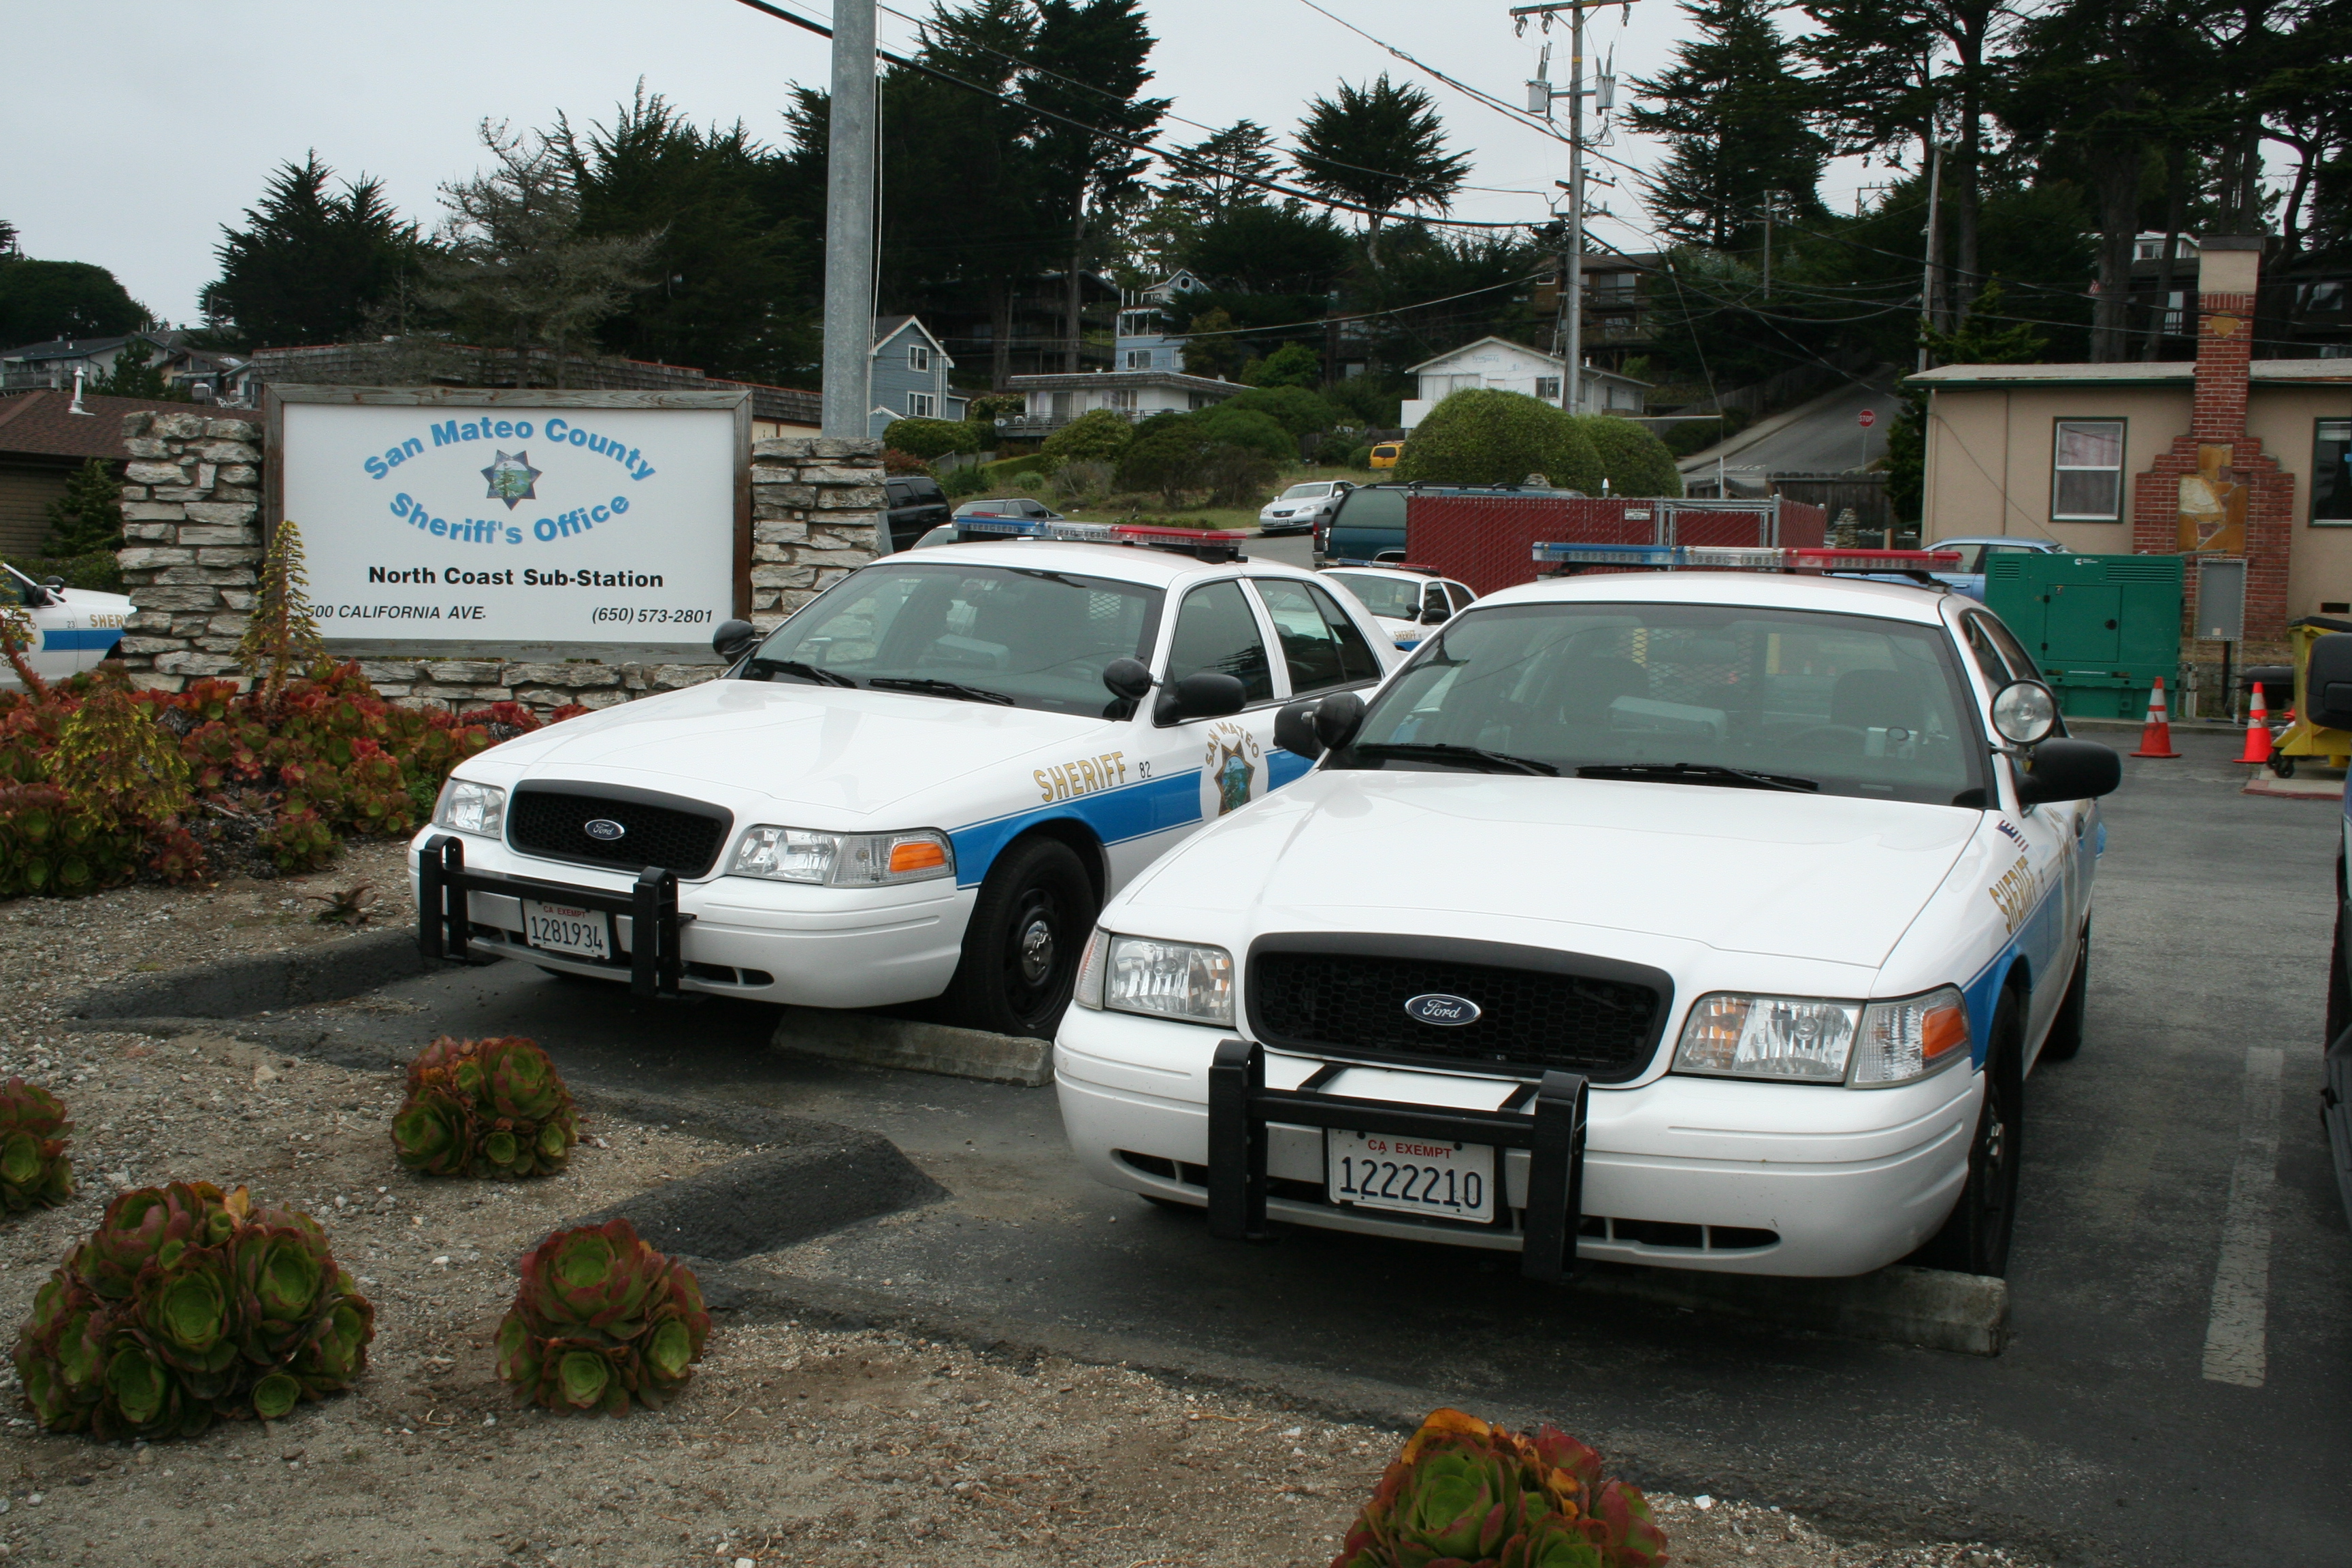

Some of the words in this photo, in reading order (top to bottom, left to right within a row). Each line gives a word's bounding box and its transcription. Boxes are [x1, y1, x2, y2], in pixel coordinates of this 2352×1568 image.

[363, 436, 425, 480] San
[430, 416, 534, 447] Mateo
[544, 418, 657, 482] County
[389, 492, 524, 544] Sheriff's
[534, 495, 630, 542] Office
[368, 566, 436, 585] North
[444, 567, 514, 586] Coast
[523, 568, 664, 588] Sub-Station
[90, 614, 127, 627] SHER
[338, 605, 441, 619] CALIFORNIA
[447, 606, 487, 619] AVE.
[592, 606, 634, 625] (650)
[637, 609, 713, 623] 573-2801
[1205, 728, 1221, 768] SAN
[1214, 721, 1260, 759] MATEO
[1032, 750, 1126, 802] SHERIFF
[1139, 761, 1152, 779] 82
[593, 822, 615, 836] Ford
[543, 905, 554, 913] CA
[557, 907, 586, 919] EXEMPT
[531, 915, 604, 951] 1281934
[1422, 999, 1462, 1018] Ford
[1367, 1139, 1388, 1152] CA
[1395, 1142, 1453, 1159] EXEMPT
[1339, 1156, 1482, 1209] 1222210
